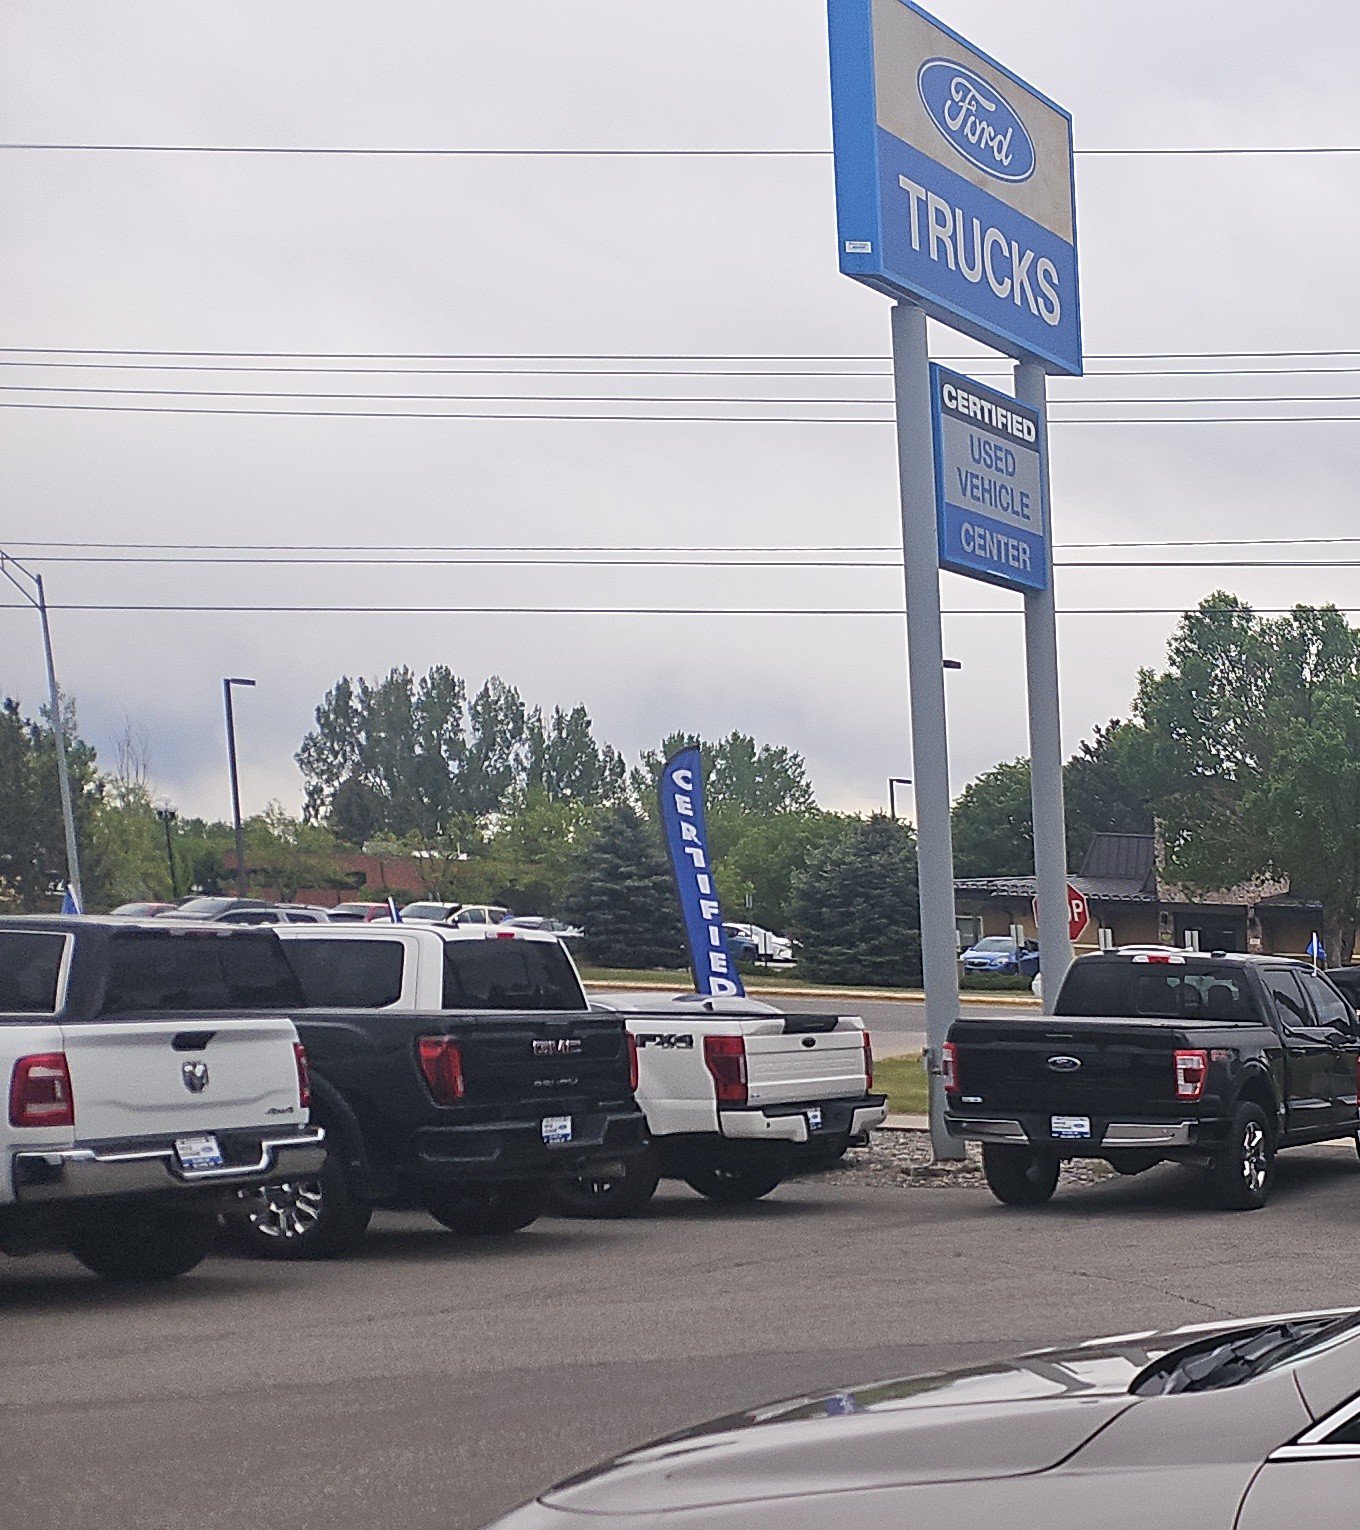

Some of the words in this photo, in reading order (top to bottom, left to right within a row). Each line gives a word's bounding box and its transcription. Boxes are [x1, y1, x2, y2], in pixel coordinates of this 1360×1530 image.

[944, 76, 1013, 167] Ford
[898, 174, 1062, 327] TRUCKS
[942, 383, 1036, 443] CERTIFIED
[969, 433, 1017, 478] USED
[956, 466, 1031, 521] VEHICLE
[960, 522, 1031, 572] CENTER
[671, 769, 738, 998] CERTIFIED
[532, 1039, 582, 1055] GMC
